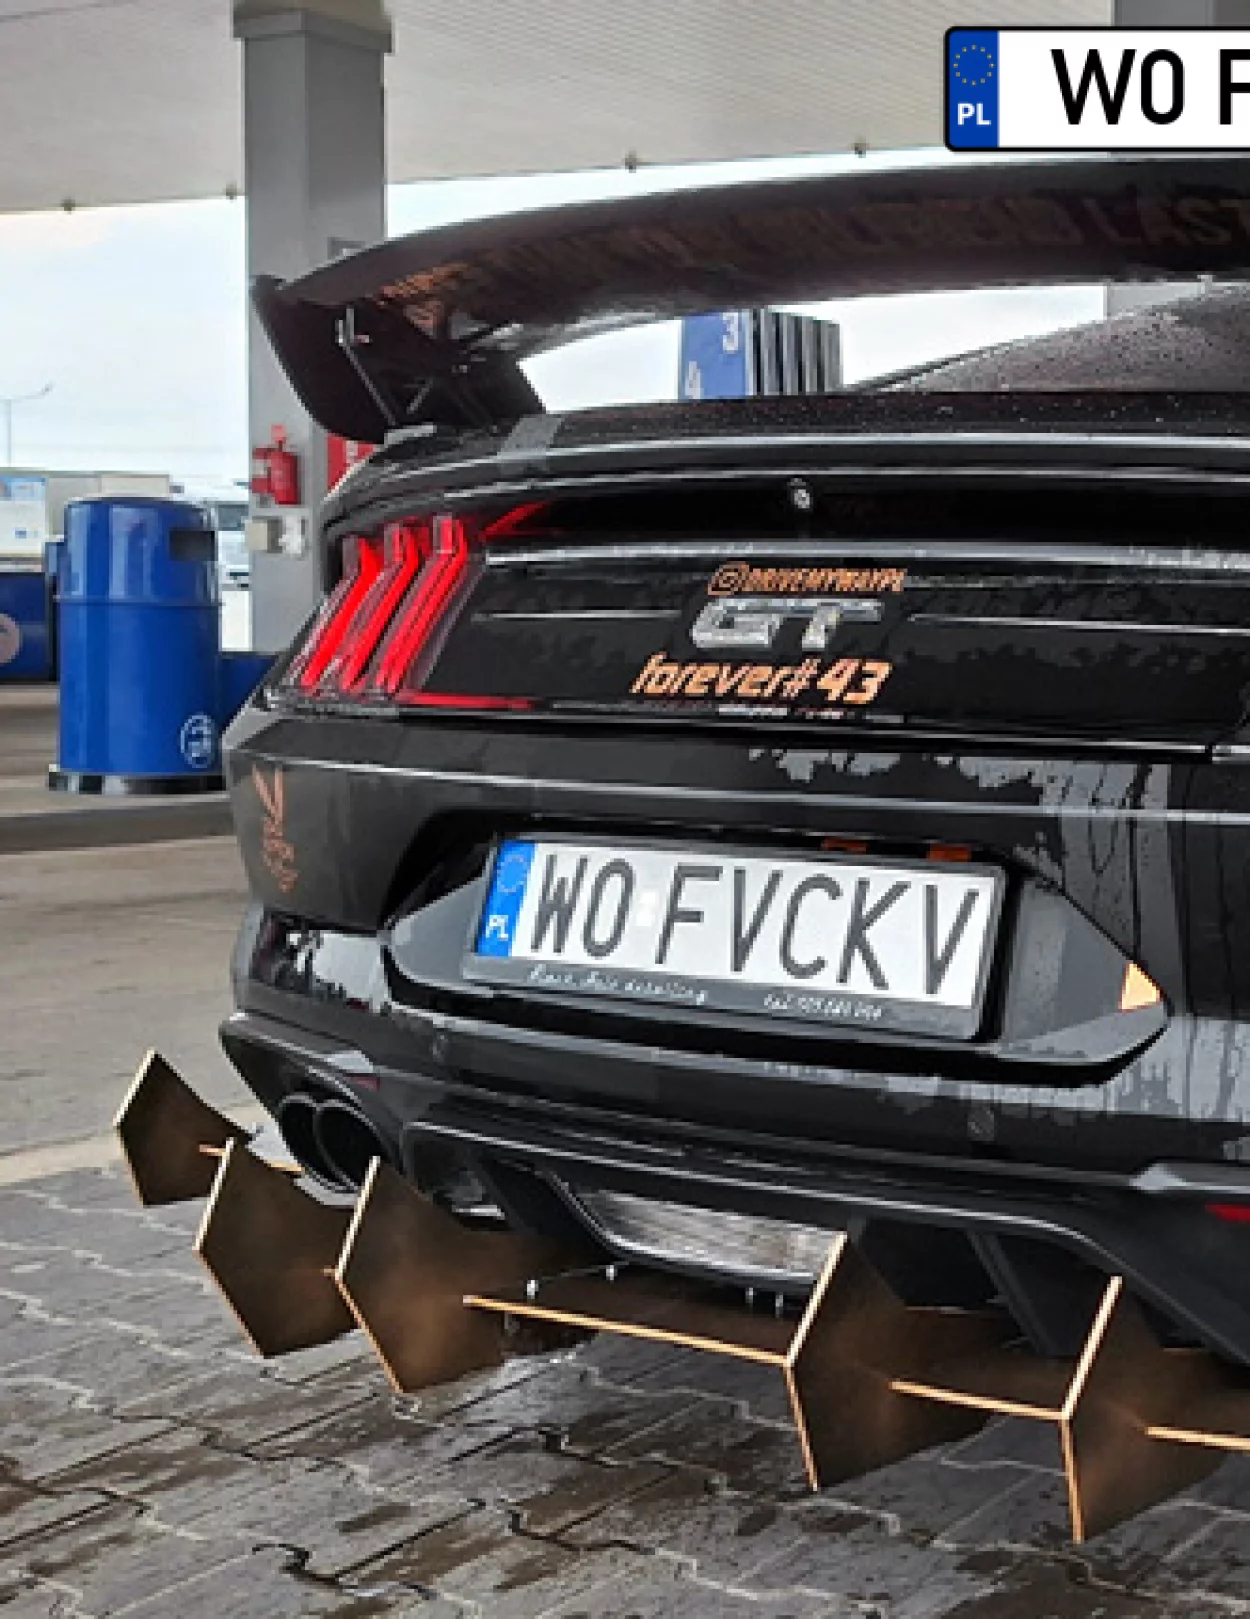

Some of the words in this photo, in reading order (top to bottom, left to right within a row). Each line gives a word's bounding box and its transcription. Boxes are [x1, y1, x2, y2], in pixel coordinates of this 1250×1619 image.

[722, 312, 739, 354] 3
[690, 597, 885, 649] GT
[485, 914, 510, 941] PL
[654, 864, 980, 995] FVCKV
